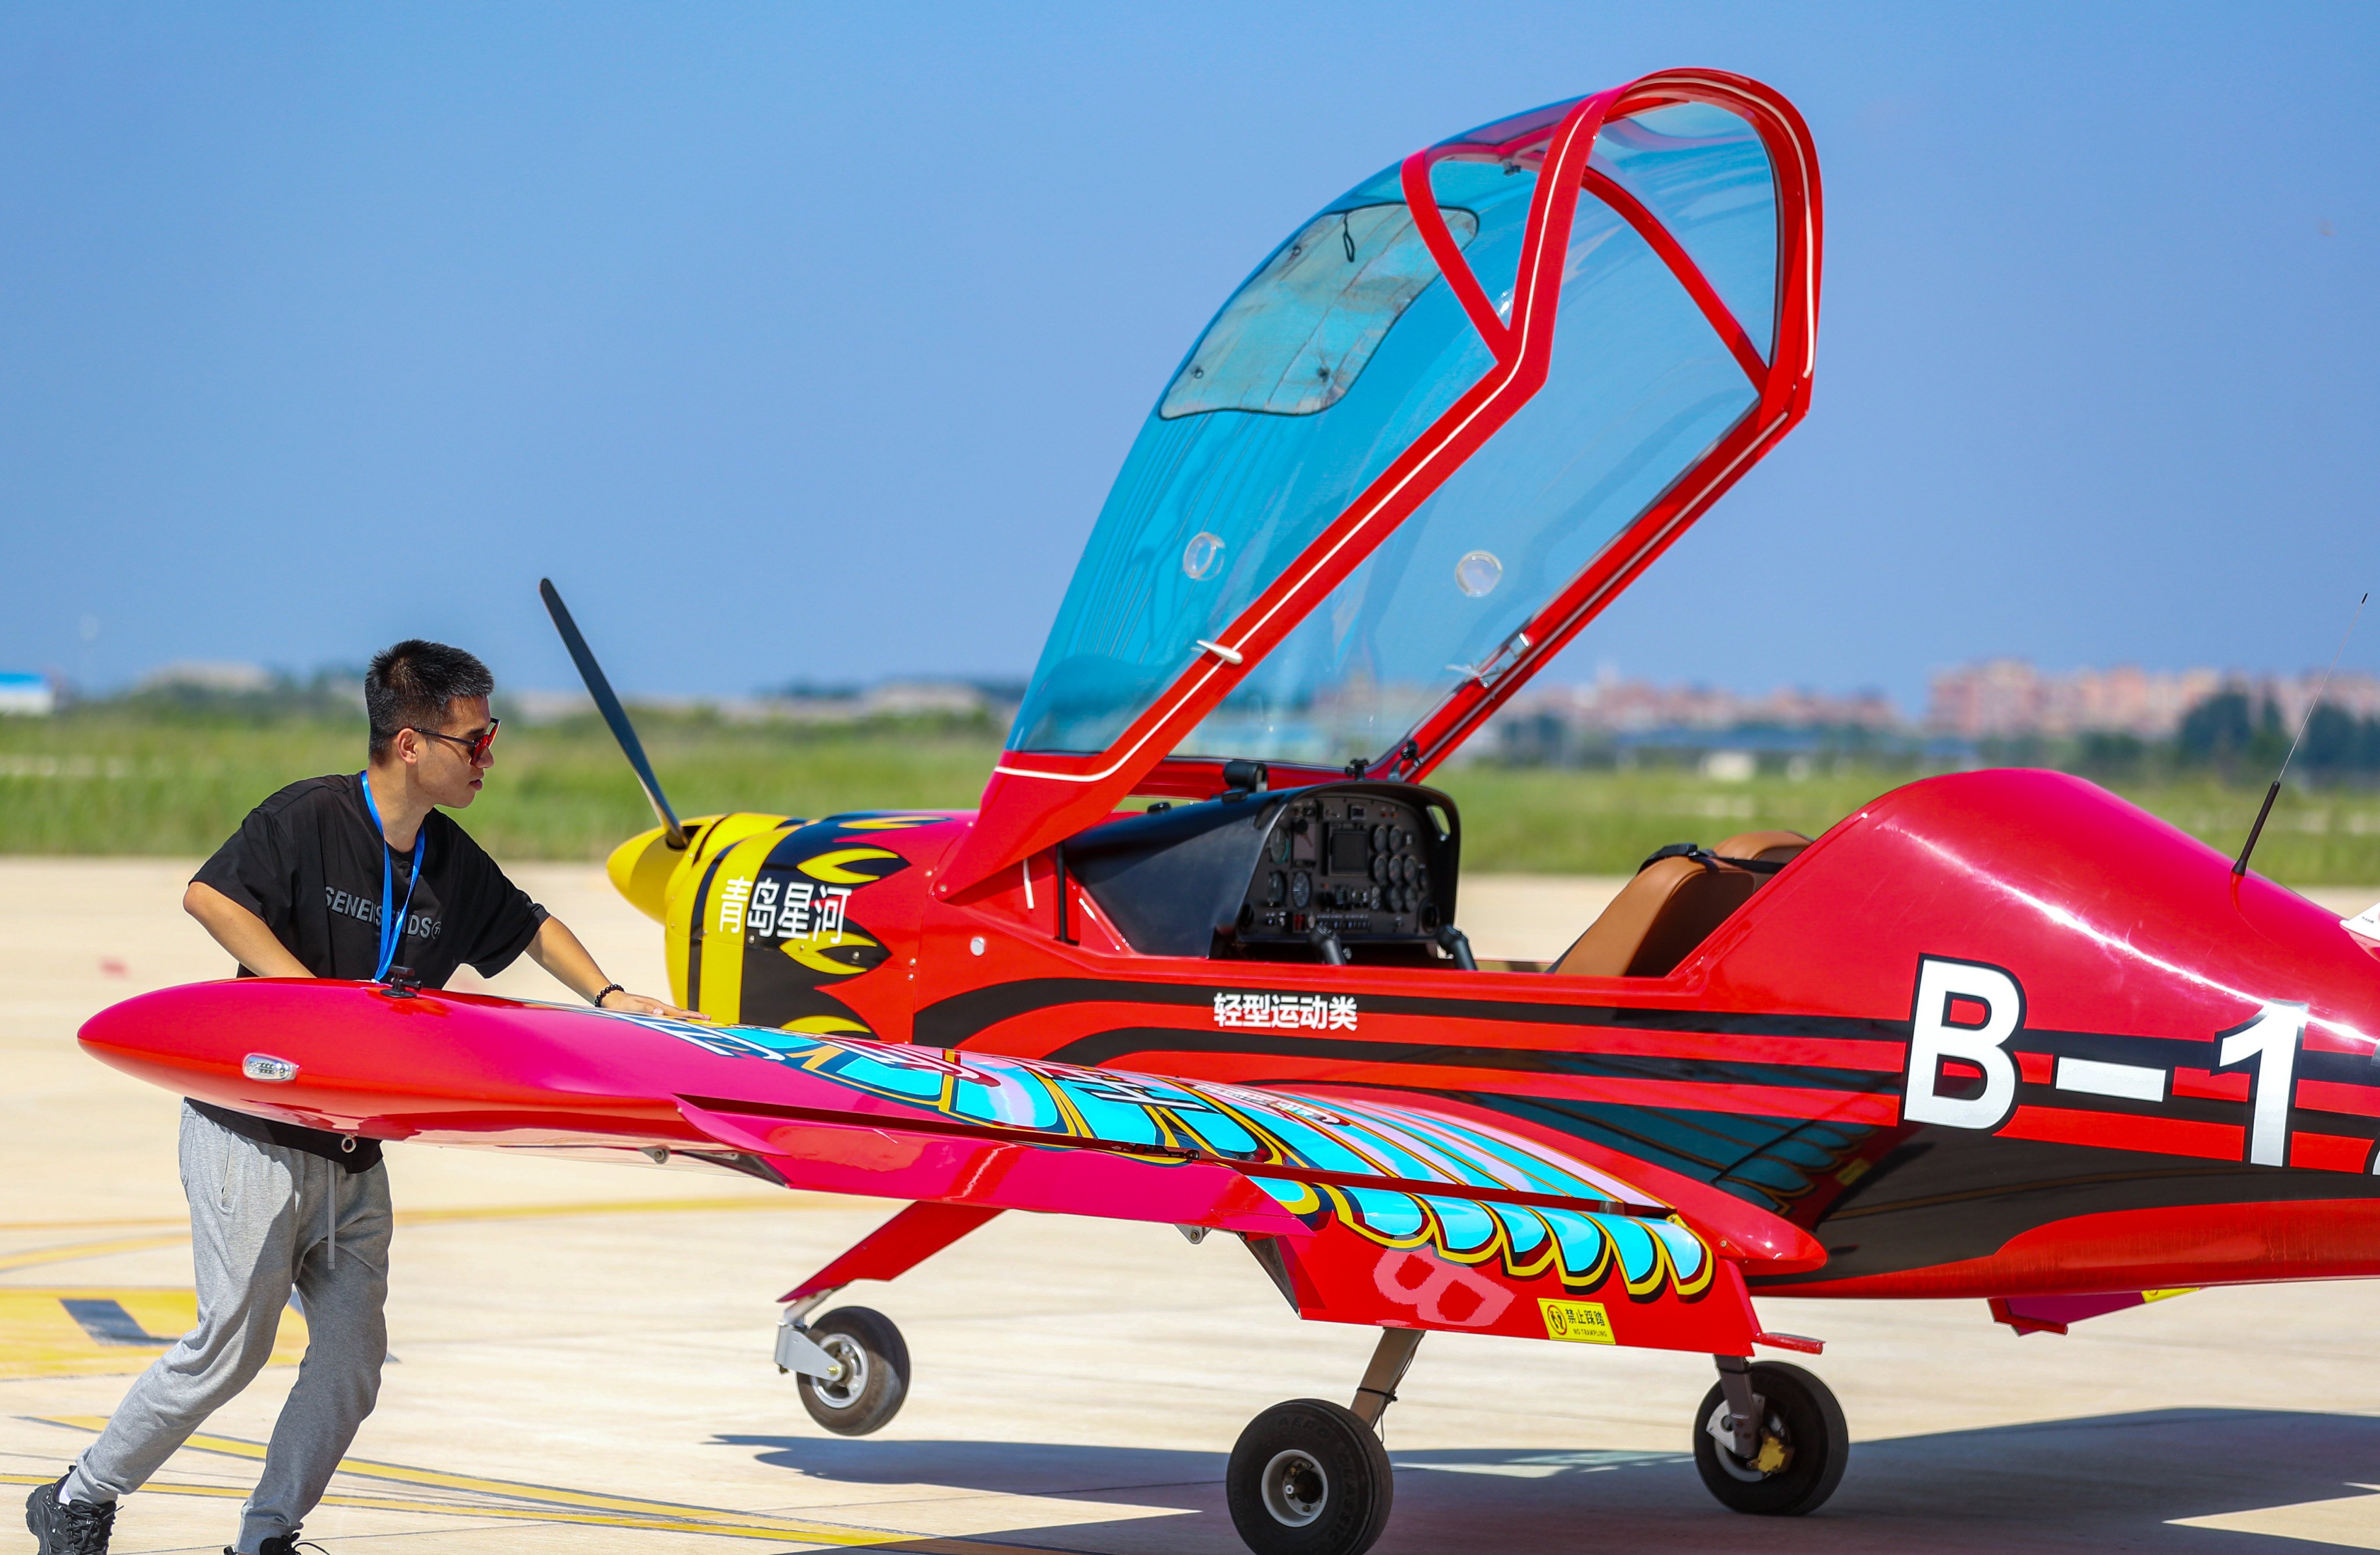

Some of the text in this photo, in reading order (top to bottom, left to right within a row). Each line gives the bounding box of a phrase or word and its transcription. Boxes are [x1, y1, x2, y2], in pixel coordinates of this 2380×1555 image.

[718, 875, 852, 944] 青岛星河
[1213, 992, 1358, 1031] 轻型运动类
[1903, 958, 2380, 1177] B-1
[1565, 1309, 1605, 1327] 禁止踩踏
[1581, 1329, 1608, 1338] TRAMPLING
